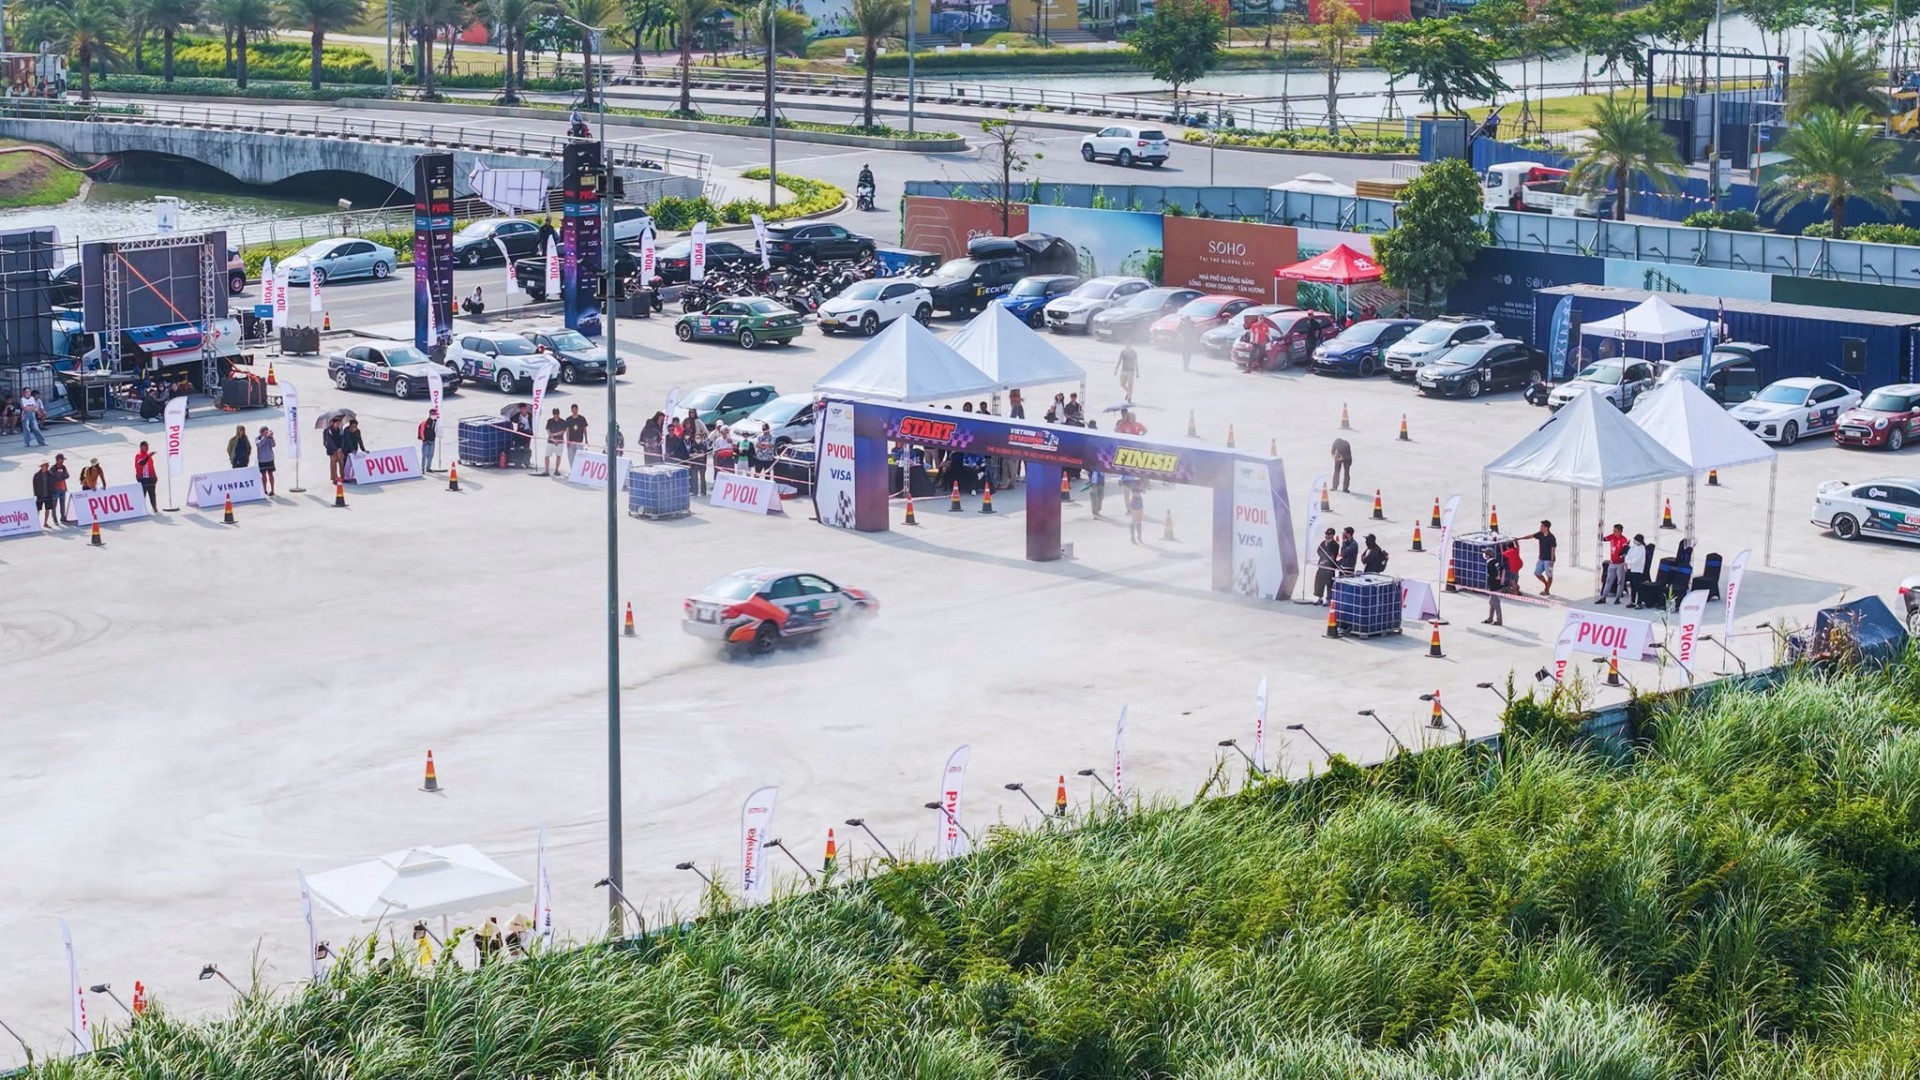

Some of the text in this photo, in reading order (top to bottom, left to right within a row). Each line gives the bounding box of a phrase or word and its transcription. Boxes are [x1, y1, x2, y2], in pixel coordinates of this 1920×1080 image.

[974, 5, 993, 23] 15
[645, 248, 654, 271] PVOIL
[694, 243, 703, 266] PVOIL
[1208, 240, 1246, 256] SOHO
[550, 256, 559, 280] PVOIL
[277, 287, 286, 312] PVOIL
[901, 417, 956, 441] START
[168, 425, 180, 457] PVOIL
[827, 443, 855, 460] PVOIL
[366, 455, 408, 476] PVOIL
[581, 460, 608, 480] PVO
[1114, 448, 1178, 472] FINISH
[217, 480, 255, 492] VINFAST
[830, 468, 852, 481] VISA
[88, 493, 134, 518] PVOIL
[722, 482, 759, 506] PVOIL
[1236, 505, 1269, 525] PVOIL
[1237, 533, 1263, 548] VISA
[1577, 621, 1628, 649] PVOIL
[1680, 623, 1695, 662] PVOIL
